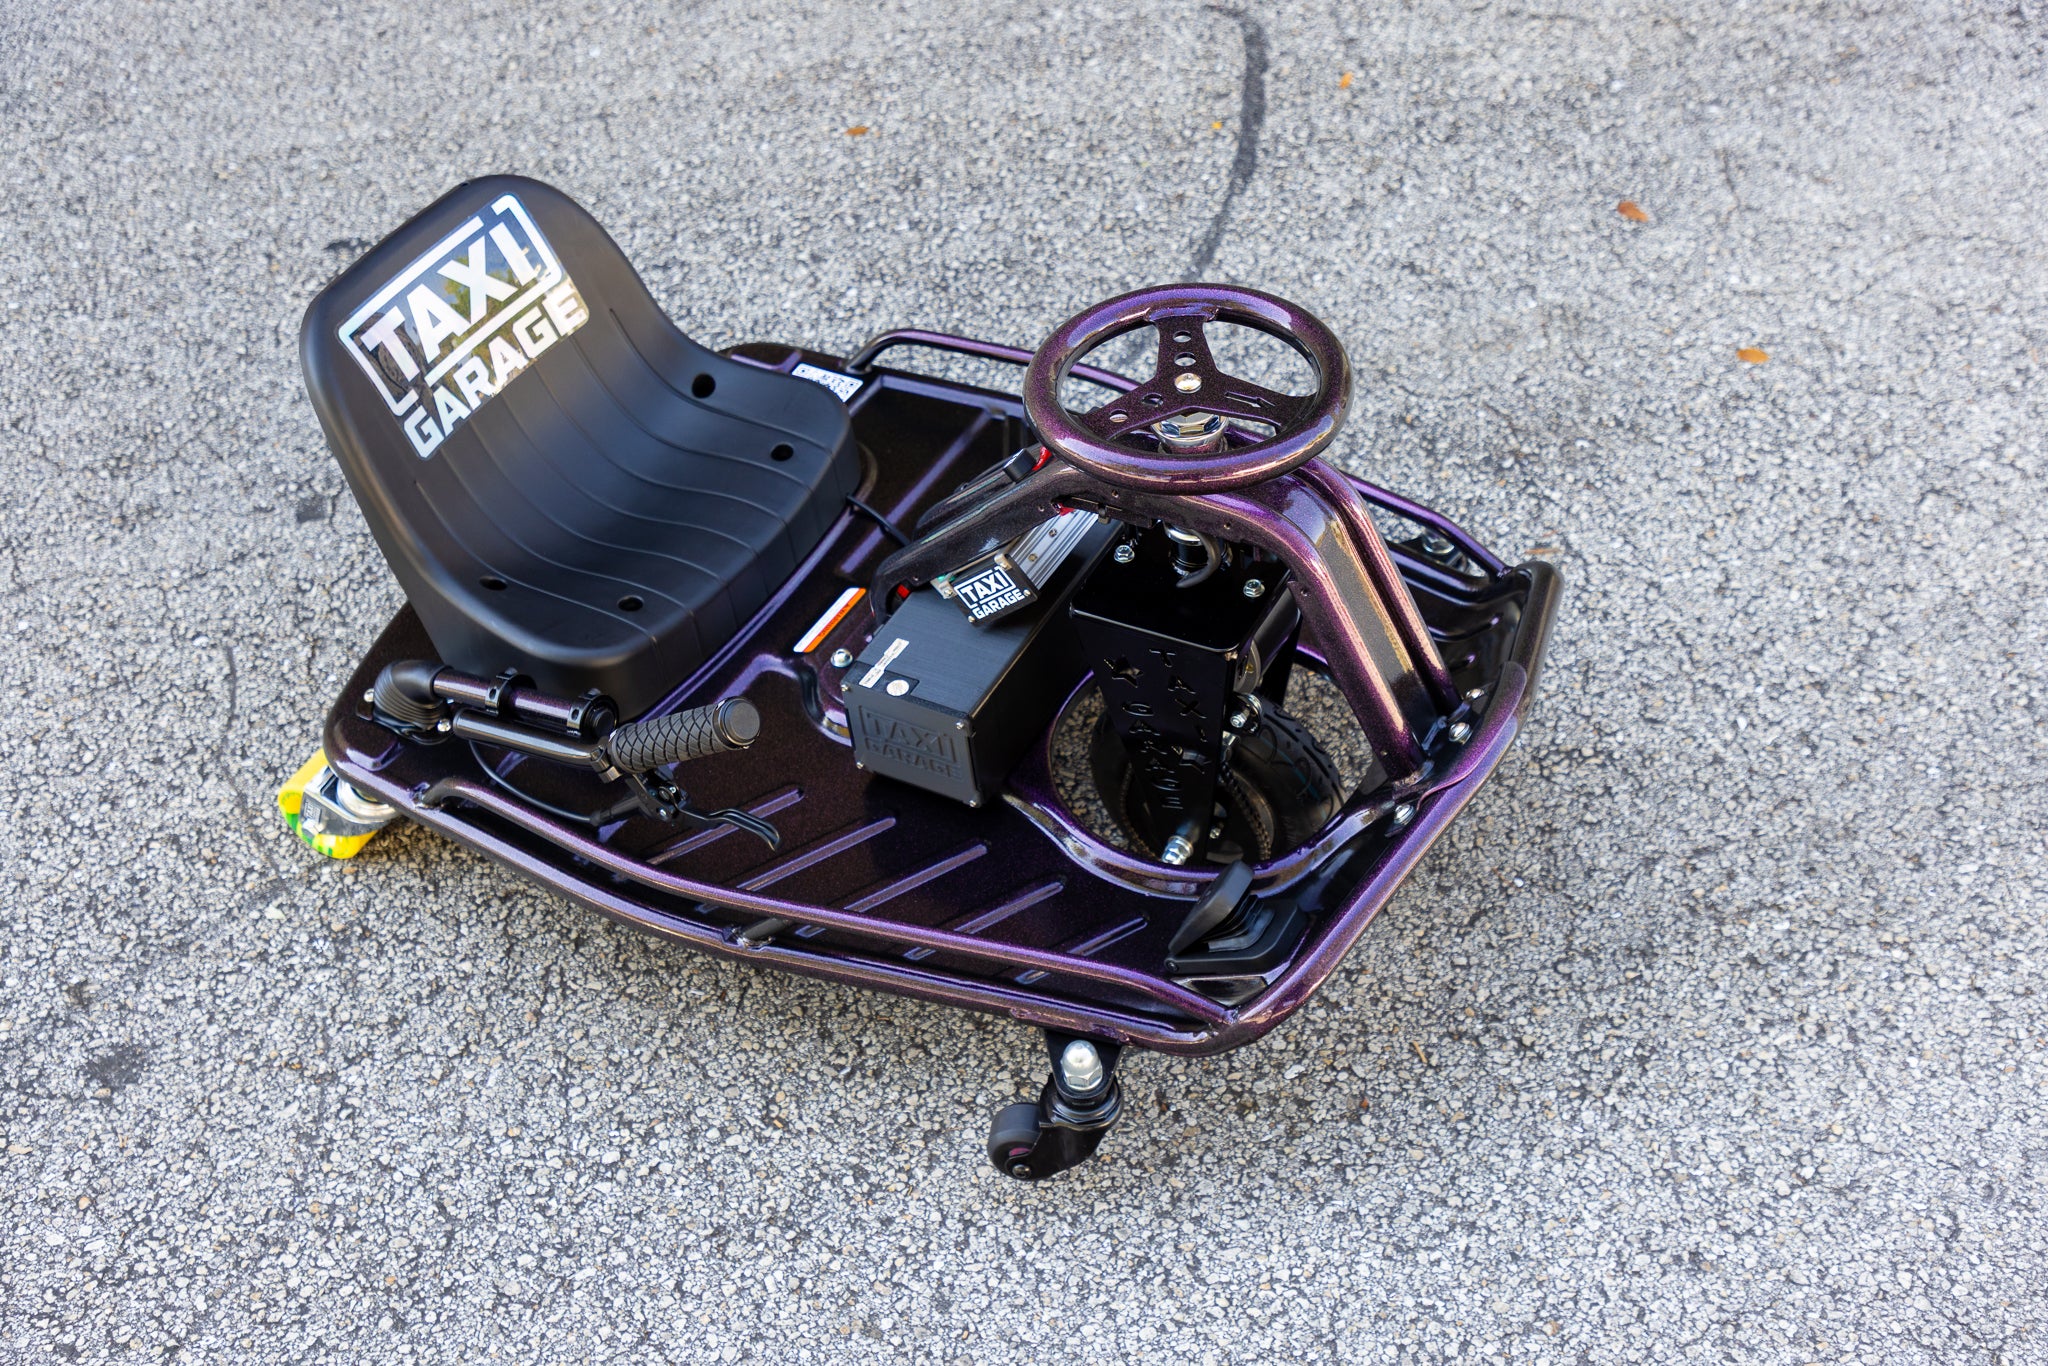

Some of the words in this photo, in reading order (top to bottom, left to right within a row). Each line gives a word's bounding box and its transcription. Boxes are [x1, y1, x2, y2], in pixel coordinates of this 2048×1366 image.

[360, 221, 538, 382] TAXI
[403, 283, 588, 459] GARAGE
[960, 571, 1009, 603] TAXI
[972, 588, 1026, 619] GARAGE
[1149, 649, 1208, 743] TAXI
[865, 710, 946, 757] TAXI
[864, 736, 965, 779] GARAGE
